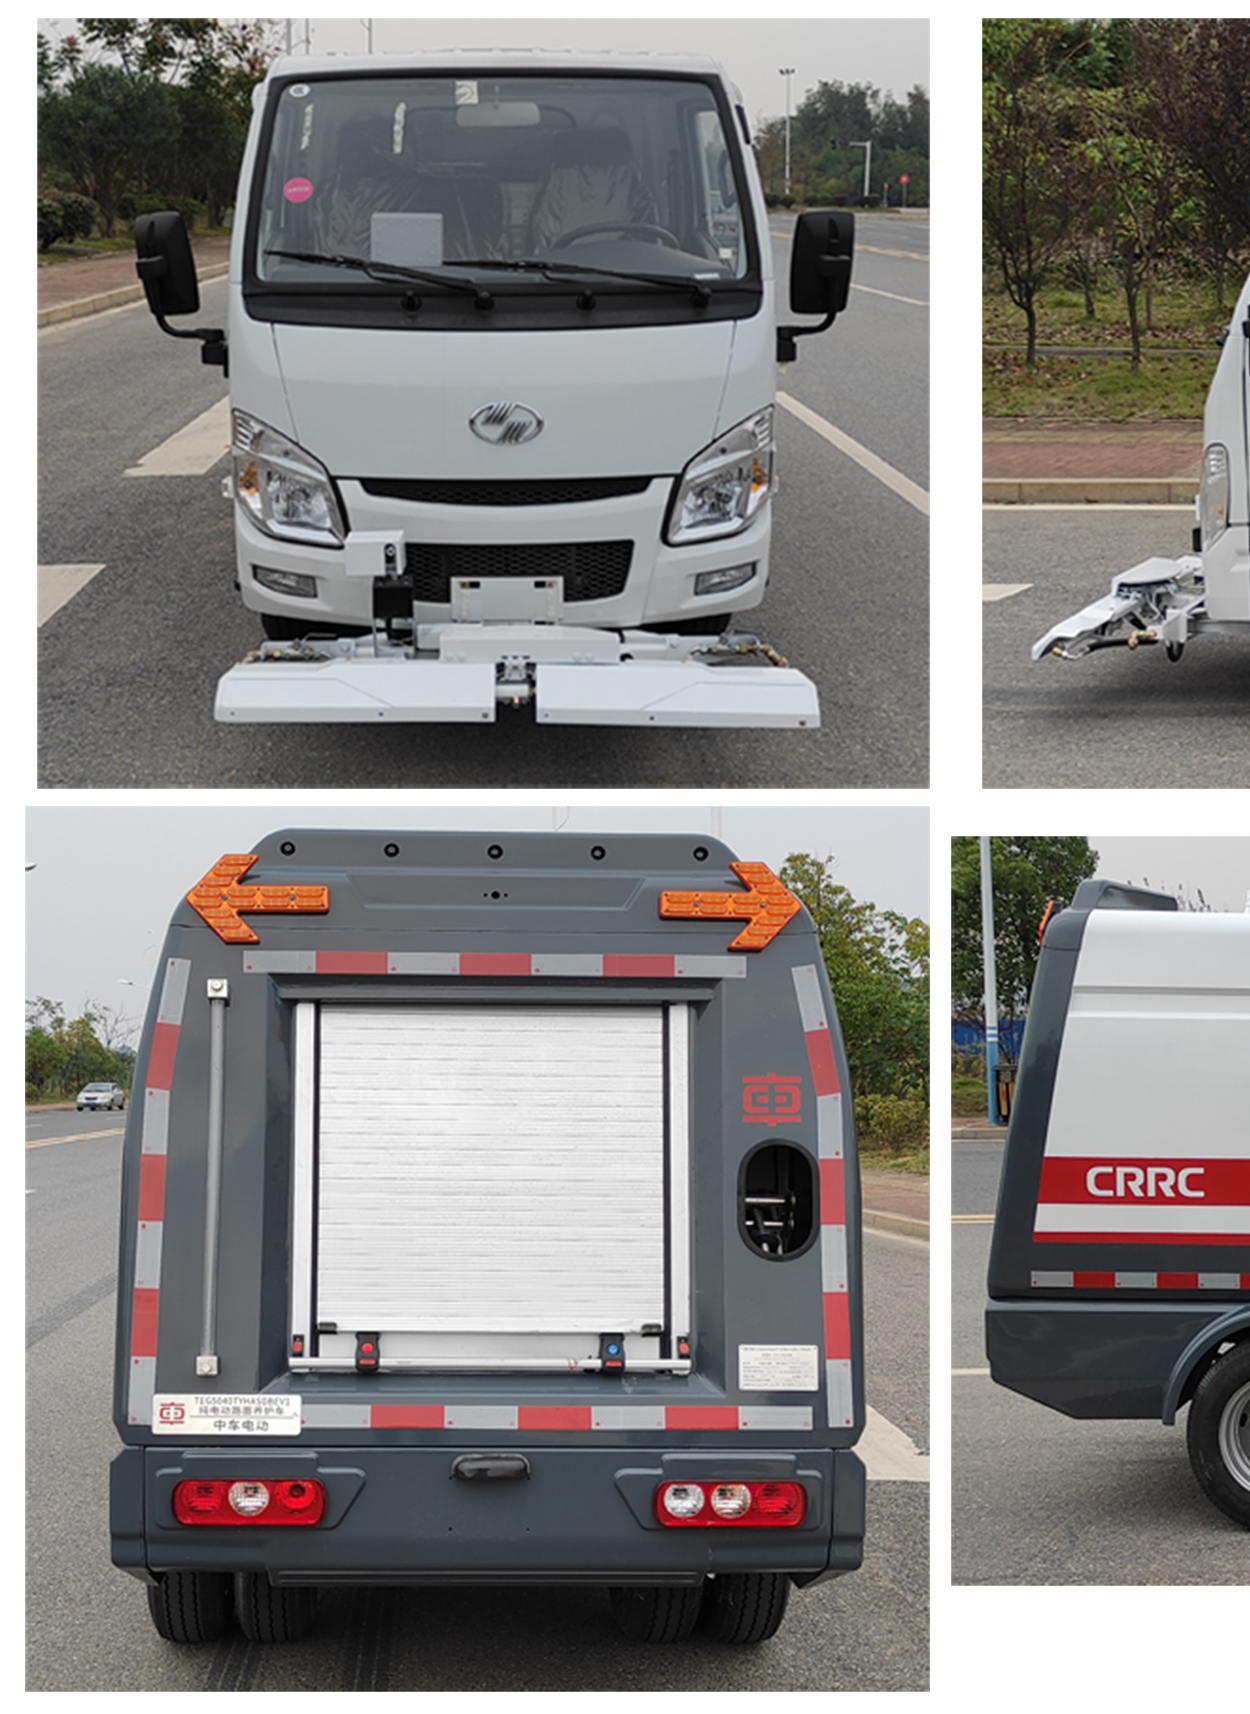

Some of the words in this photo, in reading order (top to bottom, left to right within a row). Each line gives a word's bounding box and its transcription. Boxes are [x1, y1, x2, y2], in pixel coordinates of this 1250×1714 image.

[1086, 1166, 1205, 1197] CRRC
[213, 1419, 270, 1432] 中车电动
